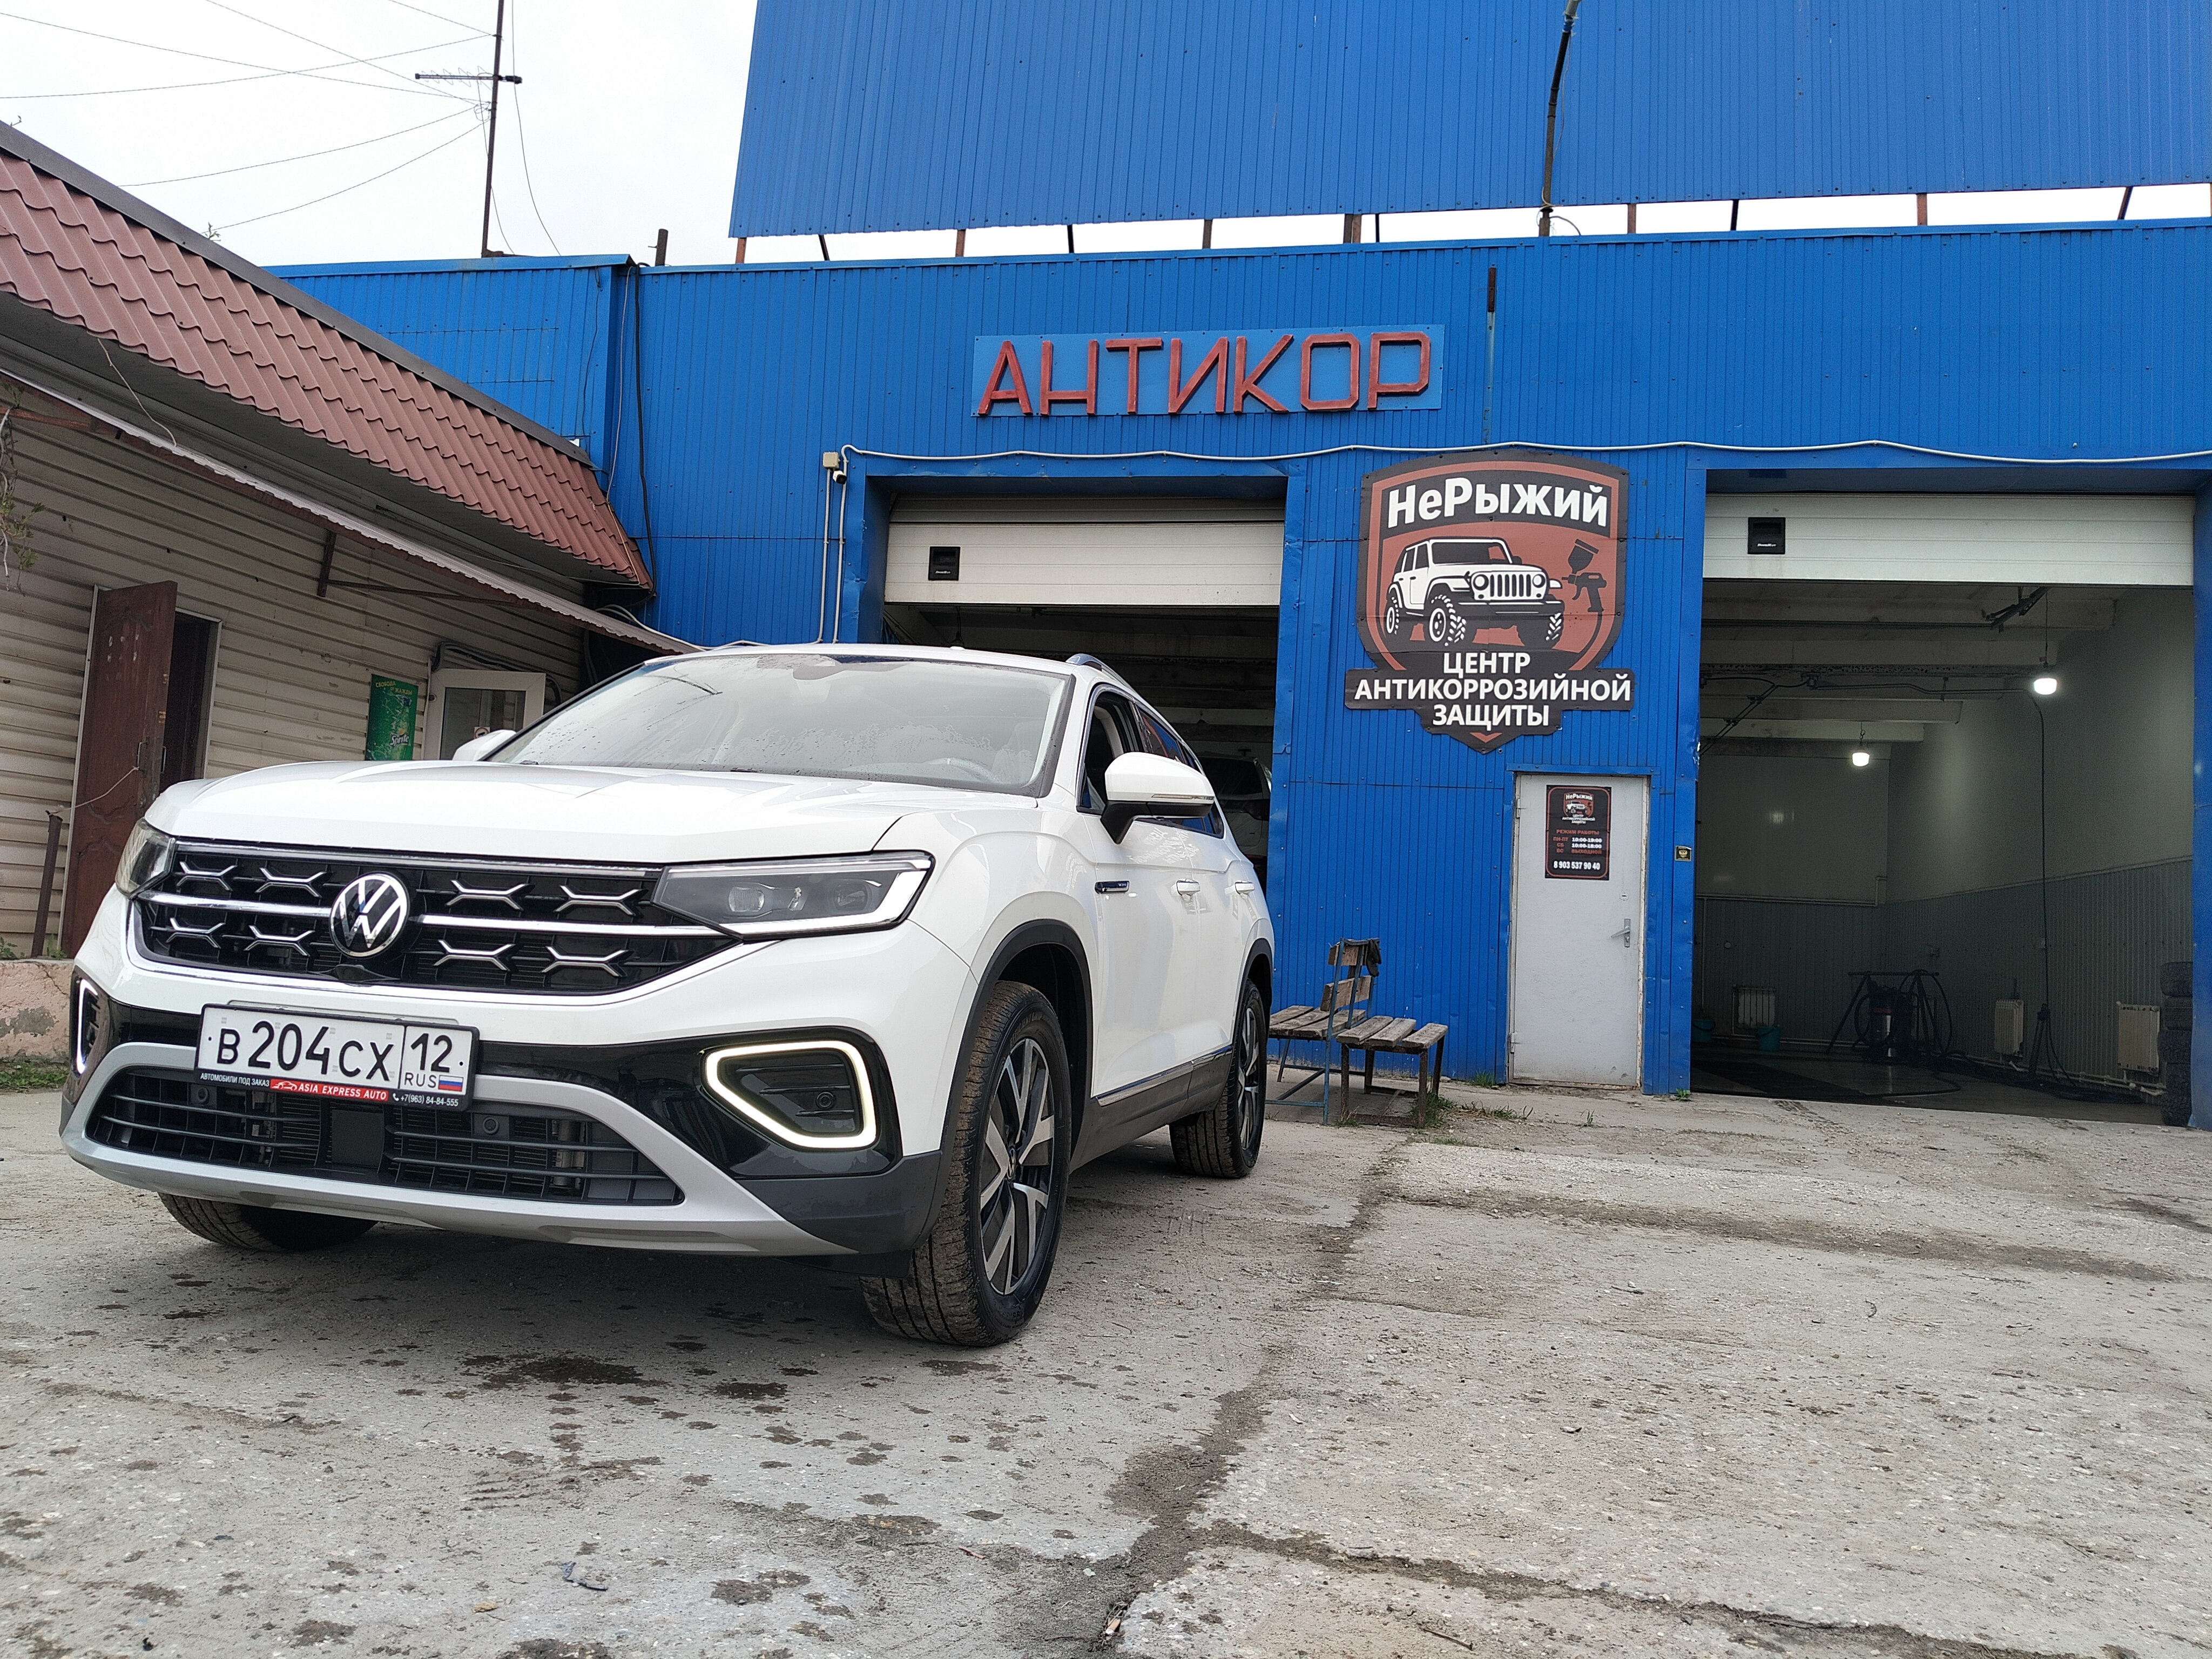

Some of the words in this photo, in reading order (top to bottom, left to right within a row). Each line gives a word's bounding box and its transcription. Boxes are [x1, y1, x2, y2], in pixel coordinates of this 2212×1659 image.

[977, 331, 1431, 416] АНТИКОР
[1387, 477, 1608, 528] НеРыжий
[1444, 652, 1530, 680] ЦЕНТР
[1354, 673, 1631, 701] АНТИКОРРОЗИЙНОЙ
[1433, 705, 1549, 731] ЗАЩИТЫ
[1559, 861, 1570, 869] 903
[1571, 861, 1583, 869] 537
[410, 1033, 453, 1073] 12
[200, 1073, 238, 1083] АВТОМОБИЛИ
[238, 1076, 251, 1085] ПОД
[251, 1078, 269, 1087] ЗАКАЗ
[298, 1083, 319, 1093] ASIA
[322, 1085, 361, 1097] EXPRESS
[363, 1089, 387, 1100] AUTO
[404, 1072, 437, 1088] RUS
[400, 1093, 425, 1104] +7(963)
[426, 1096, 458, 1107] 84-84-555
